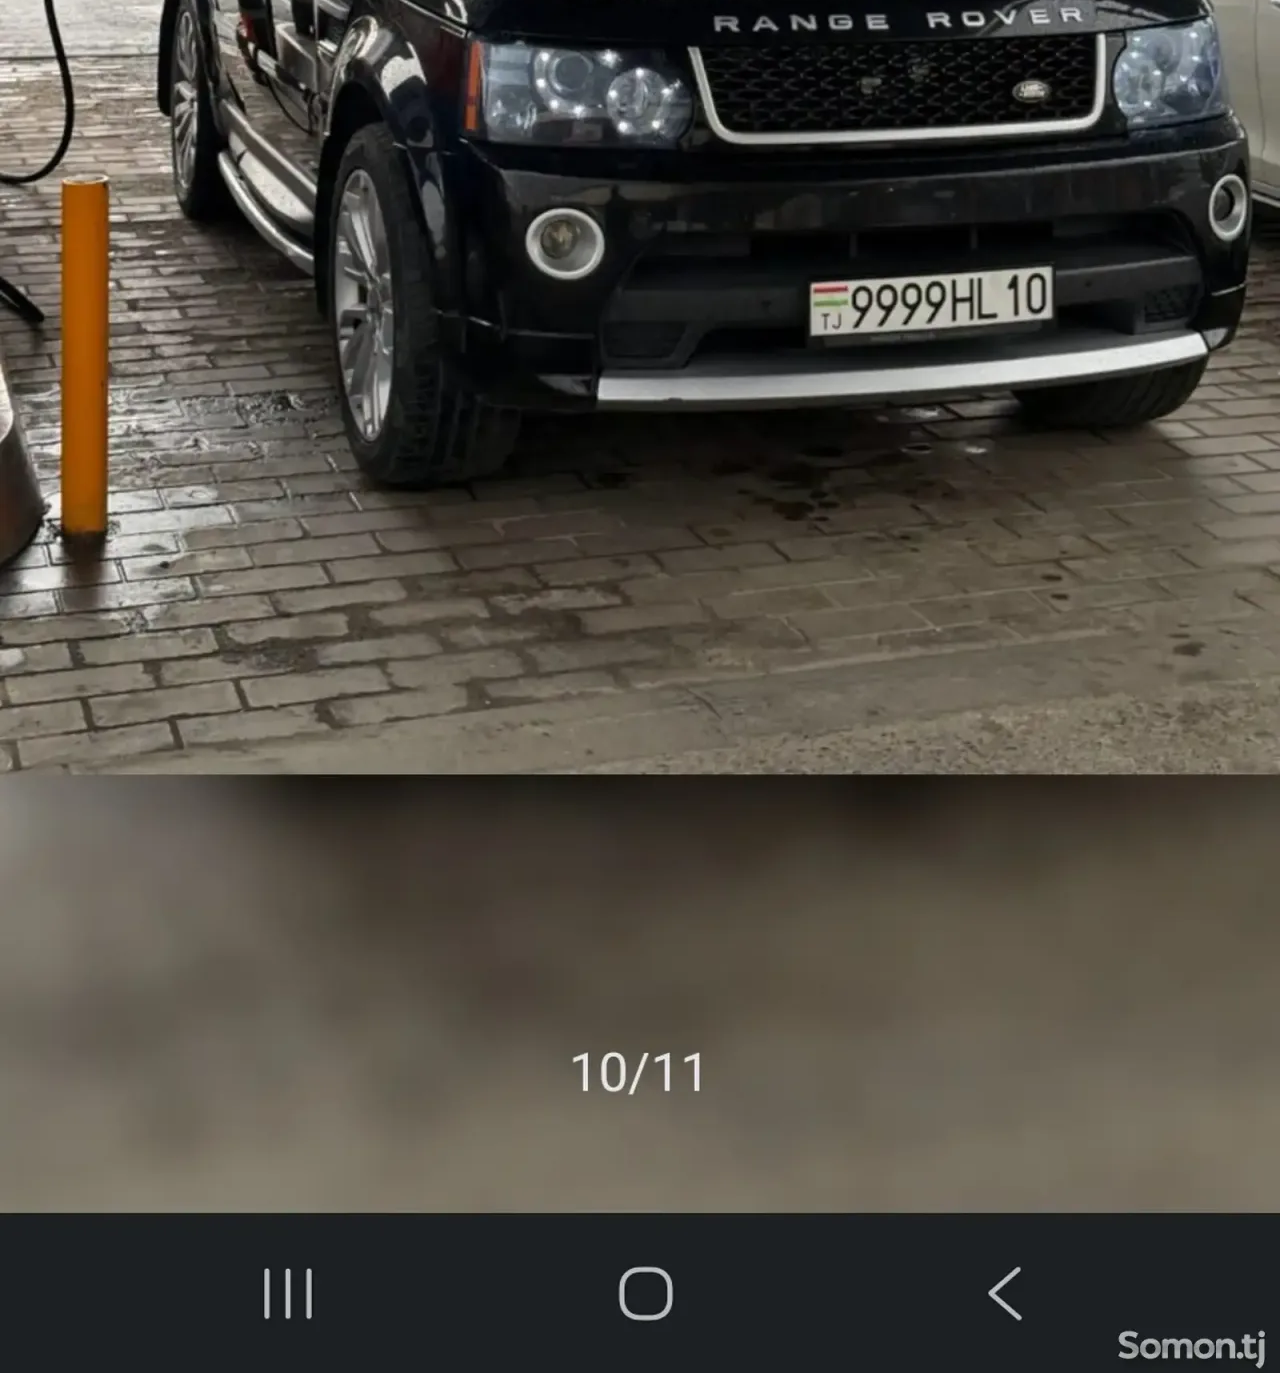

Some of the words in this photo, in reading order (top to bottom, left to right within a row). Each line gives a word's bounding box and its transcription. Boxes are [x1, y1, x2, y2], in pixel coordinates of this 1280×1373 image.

[713, 13, 890, 33] RANGE
[926, 6, 1084, 29] ROVER
[820, 312, 842, 331] TJ
